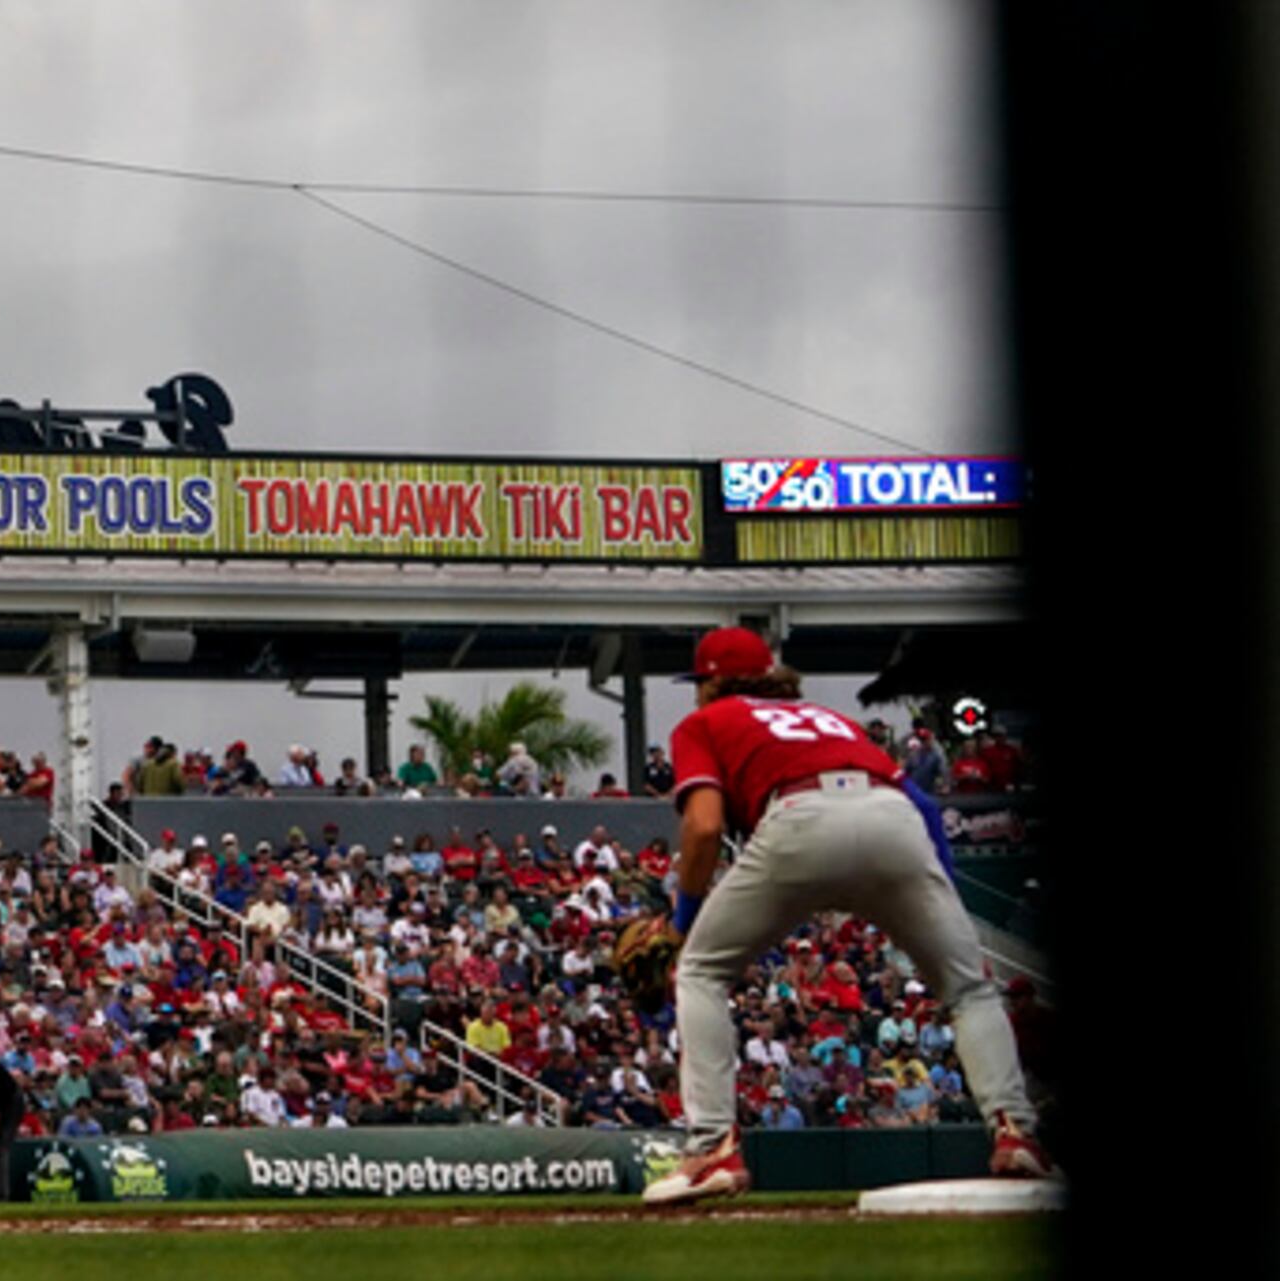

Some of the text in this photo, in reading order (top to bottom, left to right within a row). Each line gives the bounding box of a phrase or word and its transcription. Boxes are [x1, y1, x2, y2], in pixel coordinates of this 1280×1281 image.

[59, 474, 214, 537] POOLS
[841, 462, 996, 504] TOTAL:
[238, 477, 485, 539] TOMAHAWK
[597, 484, 694, 545] BAR
[244, 1148, 617, 1196] baysidepetresort.com
